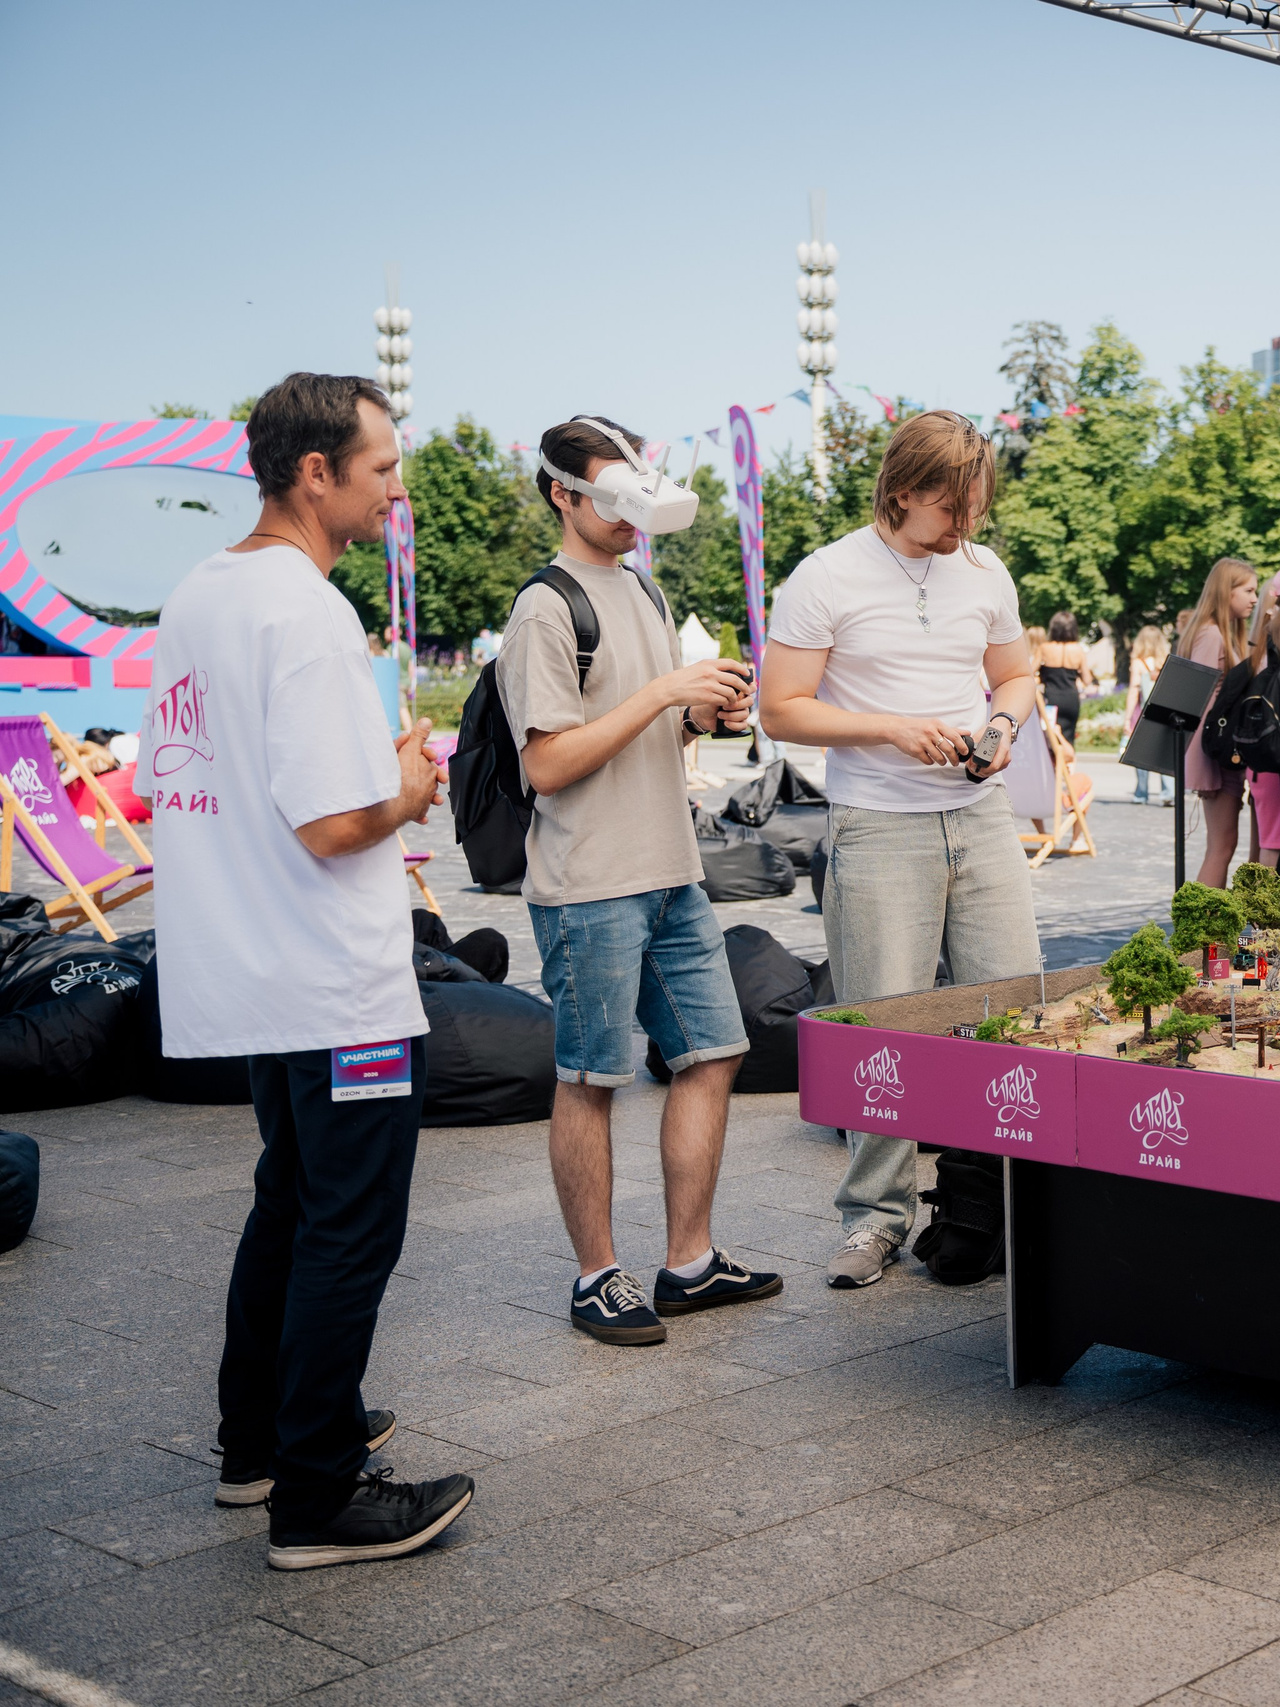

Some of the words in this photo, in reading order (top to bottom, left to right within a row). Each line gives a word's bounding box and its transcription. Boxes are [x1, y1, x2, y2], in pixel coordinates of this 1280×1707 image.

[152, 789, 219, 815] РАЙВ
[341, 1047, 401, 1064] УЧАСТНИК
[862, 1105, 899, 1121] ДРАЙВ
[994, 1126, 1033, 1142] ДРАЙВ
[1138, 1153, 1181, 1170] ДРАЙВ
